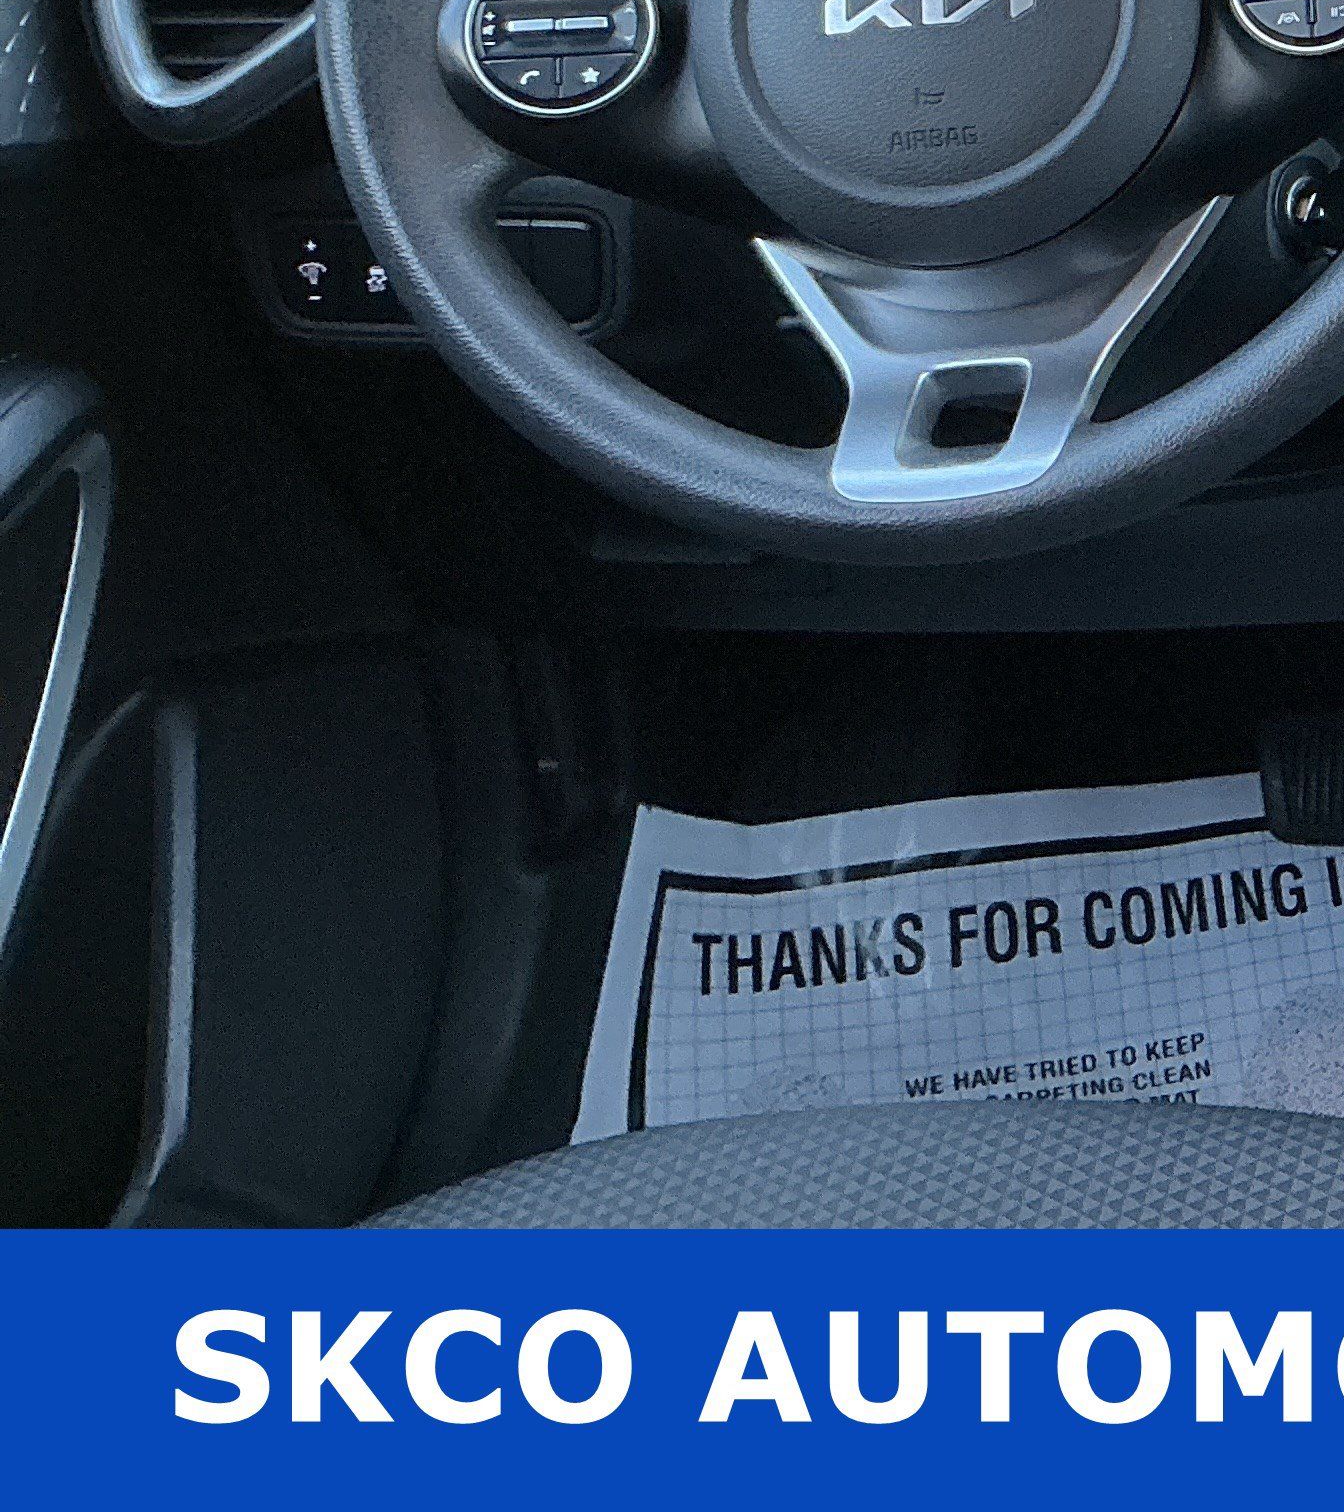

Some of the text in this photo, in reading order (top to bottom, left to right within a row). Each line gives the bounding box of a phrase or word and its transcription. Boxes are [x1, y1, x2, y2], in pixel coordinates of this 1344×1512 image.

[886, 125, 979, 153] AIRBAG
[692, 911, 927, 996] THANKS
[949, 897, 1063, 968] FOR
[1082, 862, 1309, 950] COMING
[904, 1031, 1206, 1099] WE HAVE TRIED TO KEEP
[1132, 1059, 1211, 1090] CLEAN
